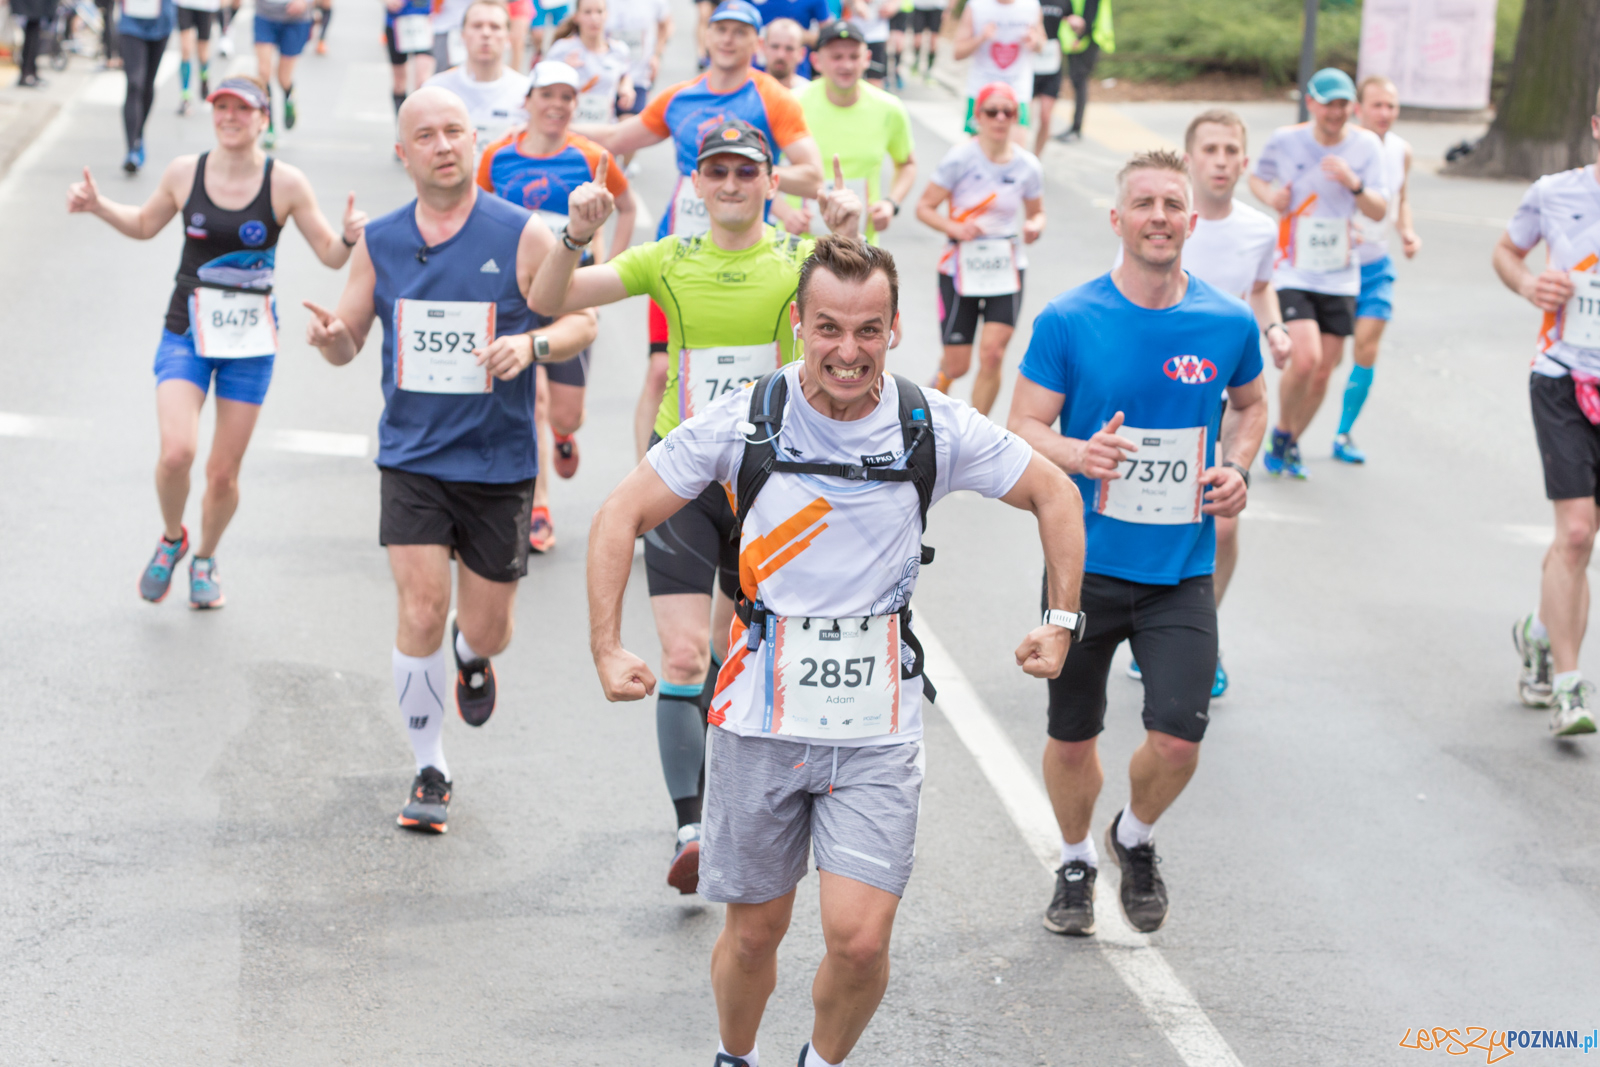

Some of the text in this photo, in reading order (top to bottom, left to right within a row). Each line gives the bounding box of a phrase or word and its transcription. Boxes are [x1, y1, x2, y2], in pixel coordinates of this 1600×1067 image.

[212, 308, 259, 328] 8475
[413, 330, 476, 353] 3593
[865, 455, 893, 465] 11.PKO
[1124, 458, 1188, 483] 7370
[799, 656, 876, 689] 2857
[825, 695, 855, 704] Adam
